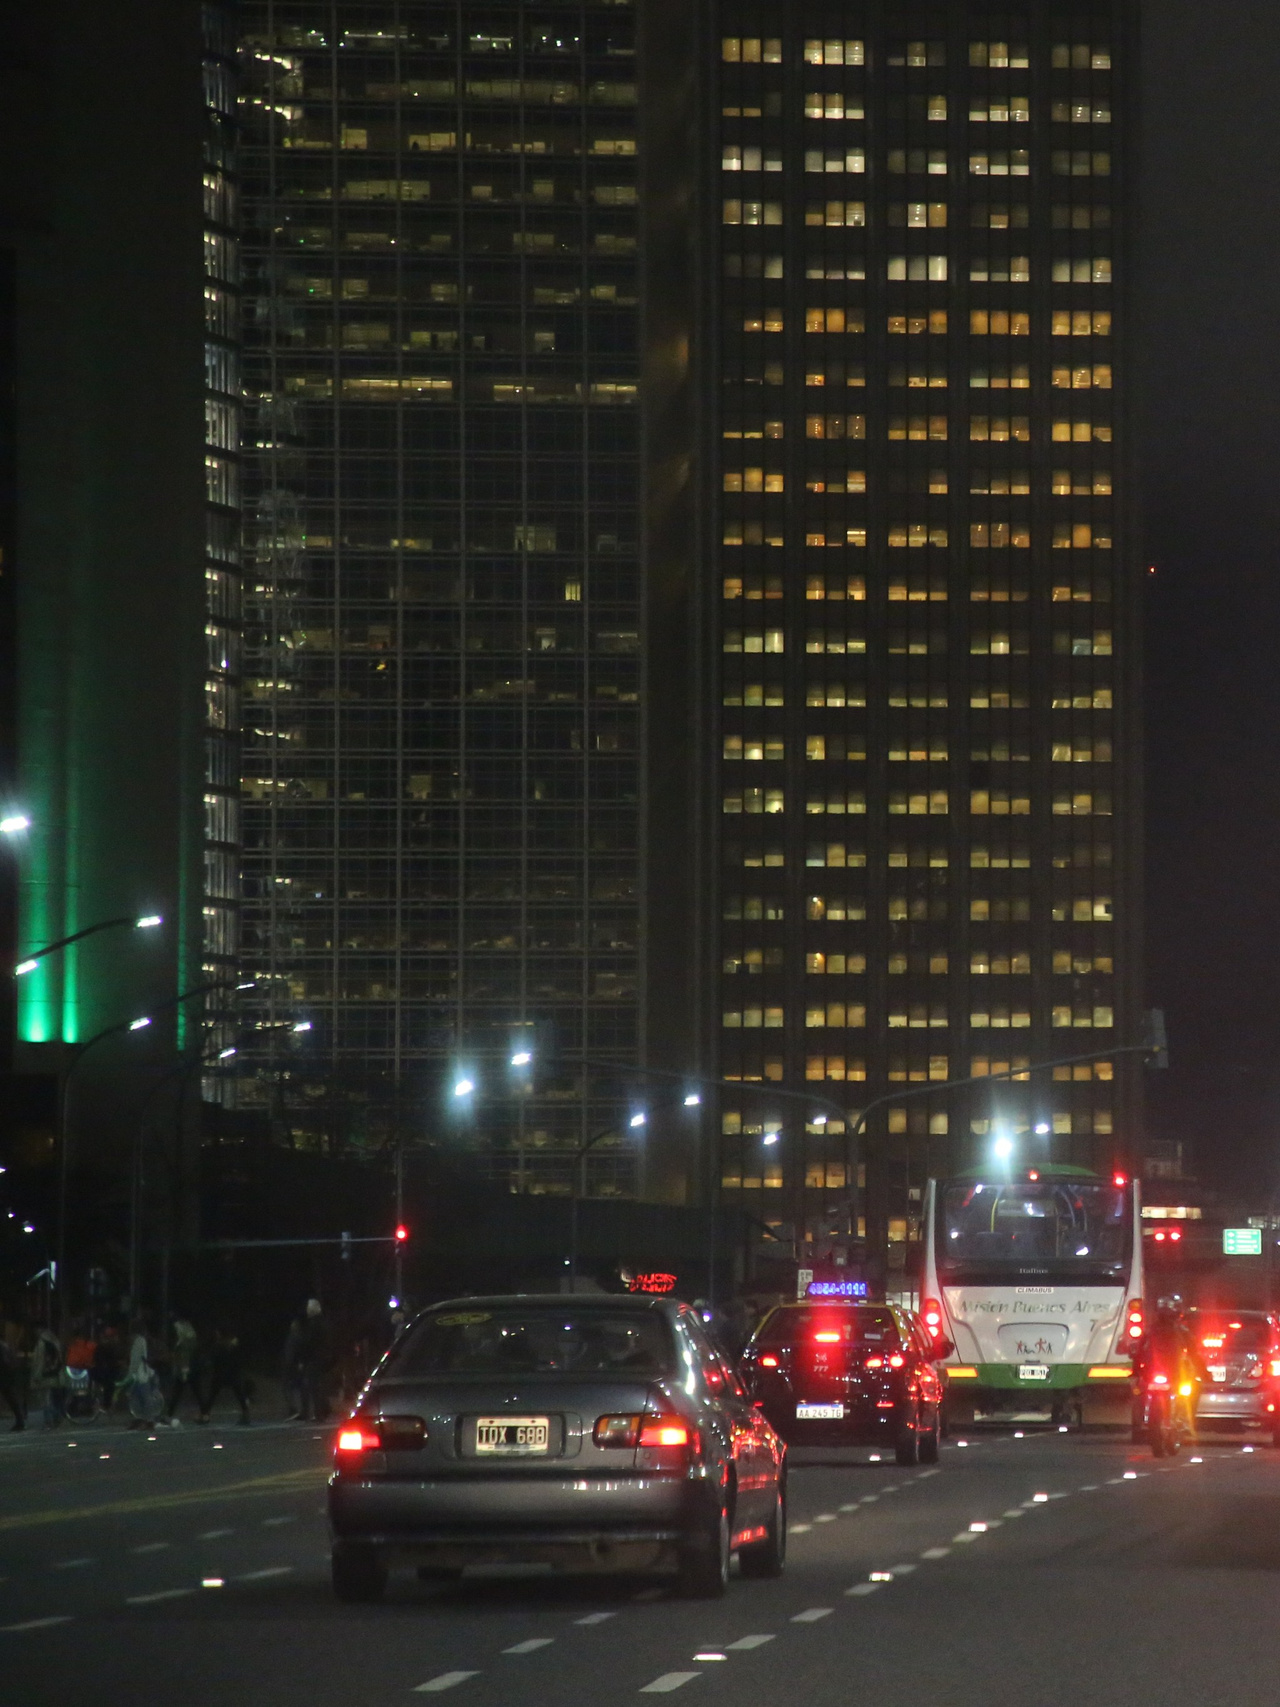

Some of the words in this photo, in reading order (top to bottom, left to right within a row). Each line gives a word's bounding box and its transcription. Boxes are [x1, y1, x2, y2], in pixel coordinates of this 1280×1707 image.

[1070, 1300, 1110, 1313] Aires
[799, 1409, 810, 1418] AA
[812, 1409, 828, 1418] 245
[516, 1426, 545, 1444] 688
